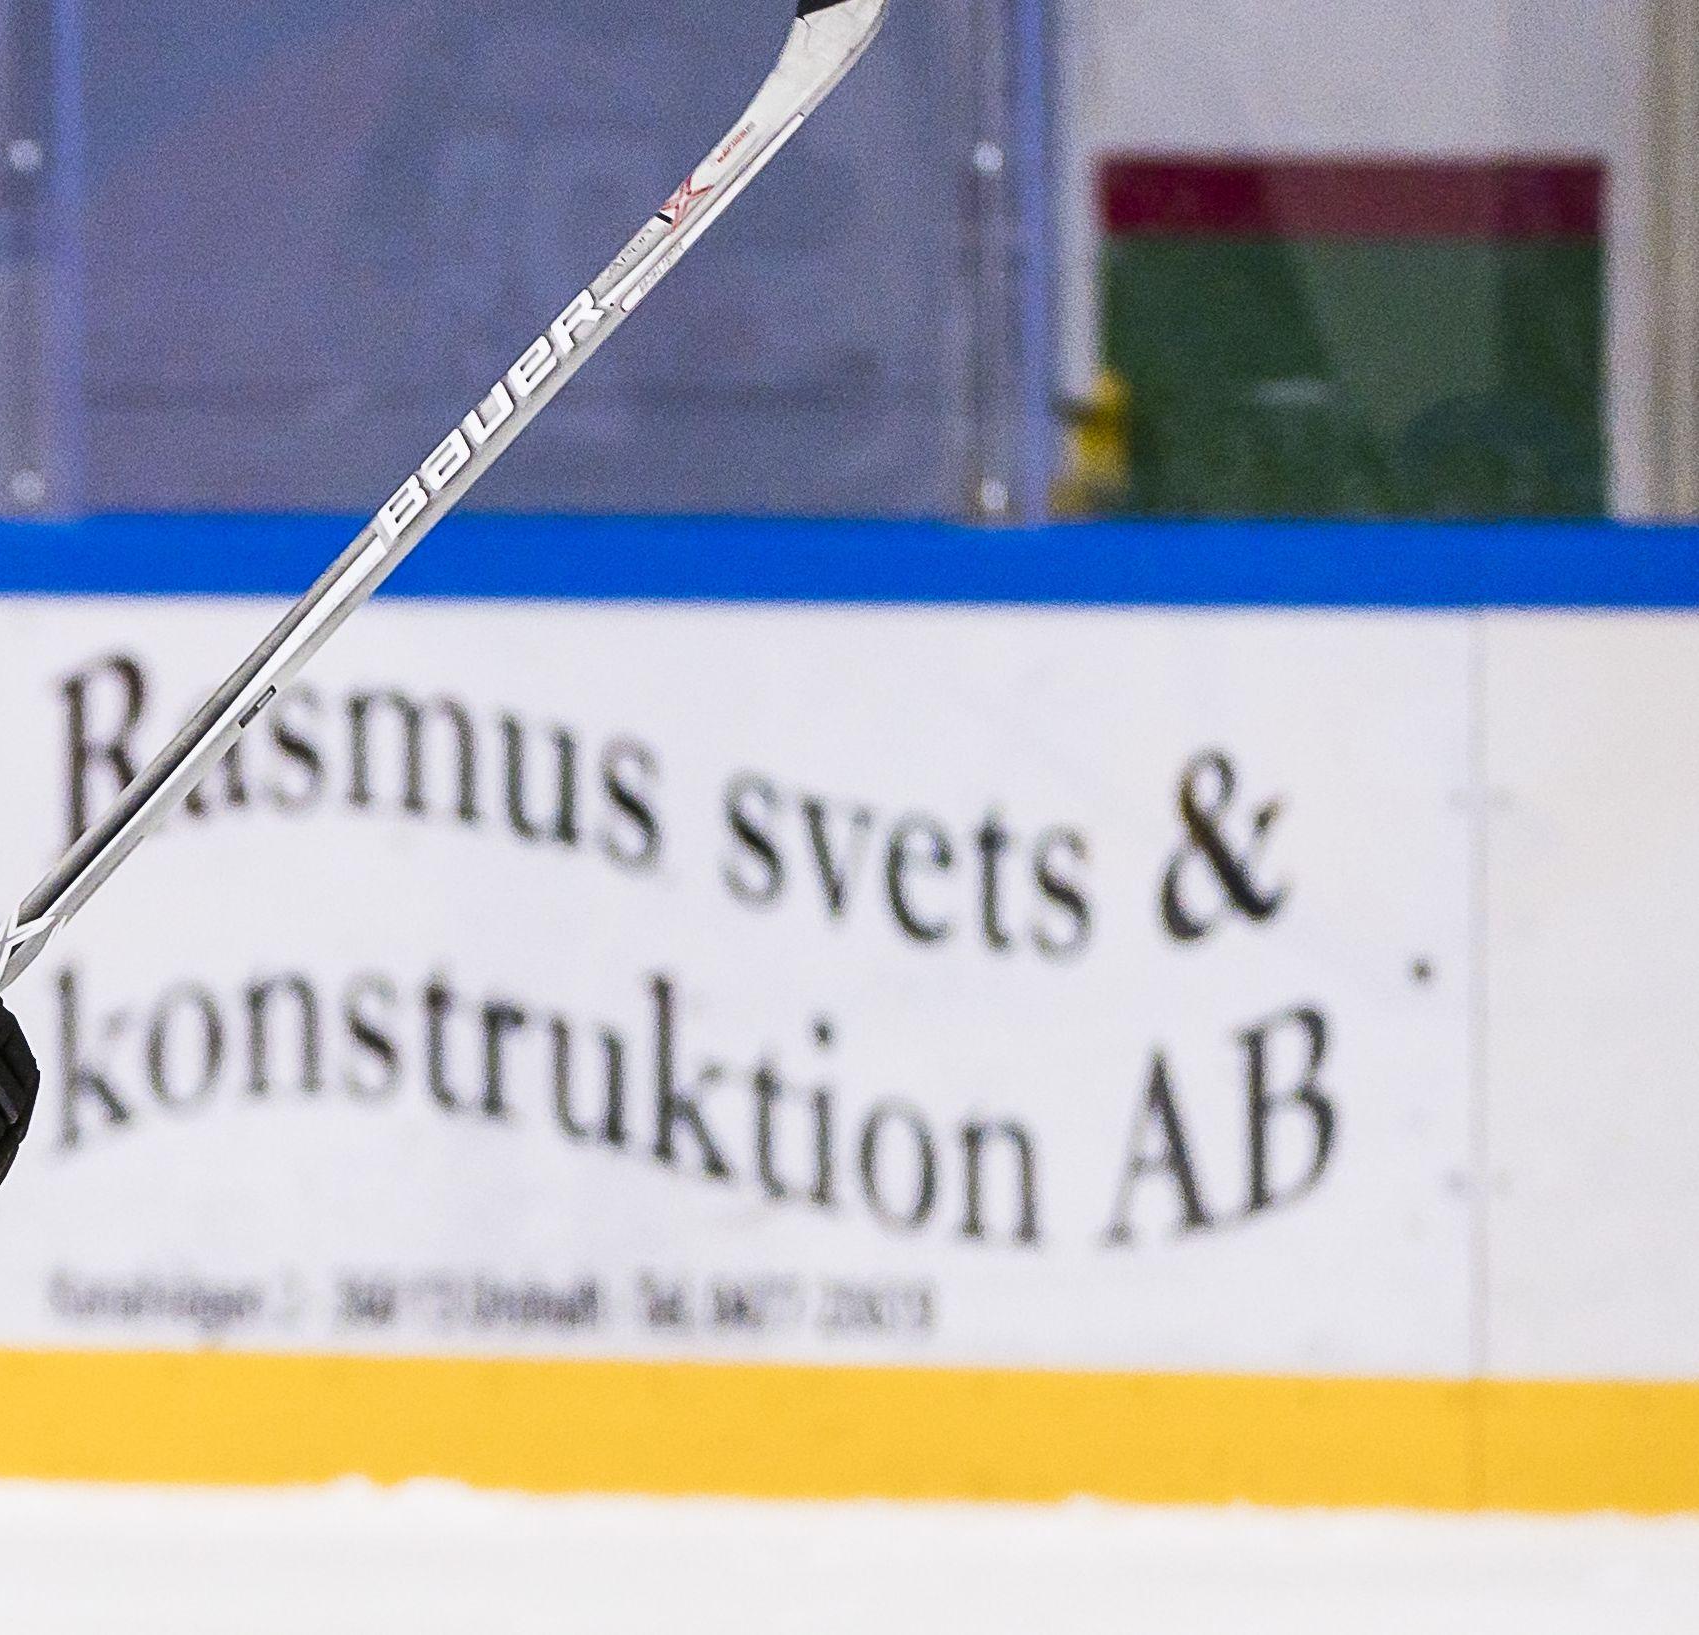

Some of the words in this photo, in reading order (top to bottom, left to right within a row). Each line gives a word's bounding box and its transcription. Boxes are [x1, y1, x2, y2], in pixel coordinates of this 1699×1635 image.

[375, 287, 605, 544] BAUER
[719, 768, 1095, 962] svets
[1158, 748, 1291, 945] &
[53, 963, 1043, 1247] konstruktion
[1099, 998, 1341, 1250] AB
